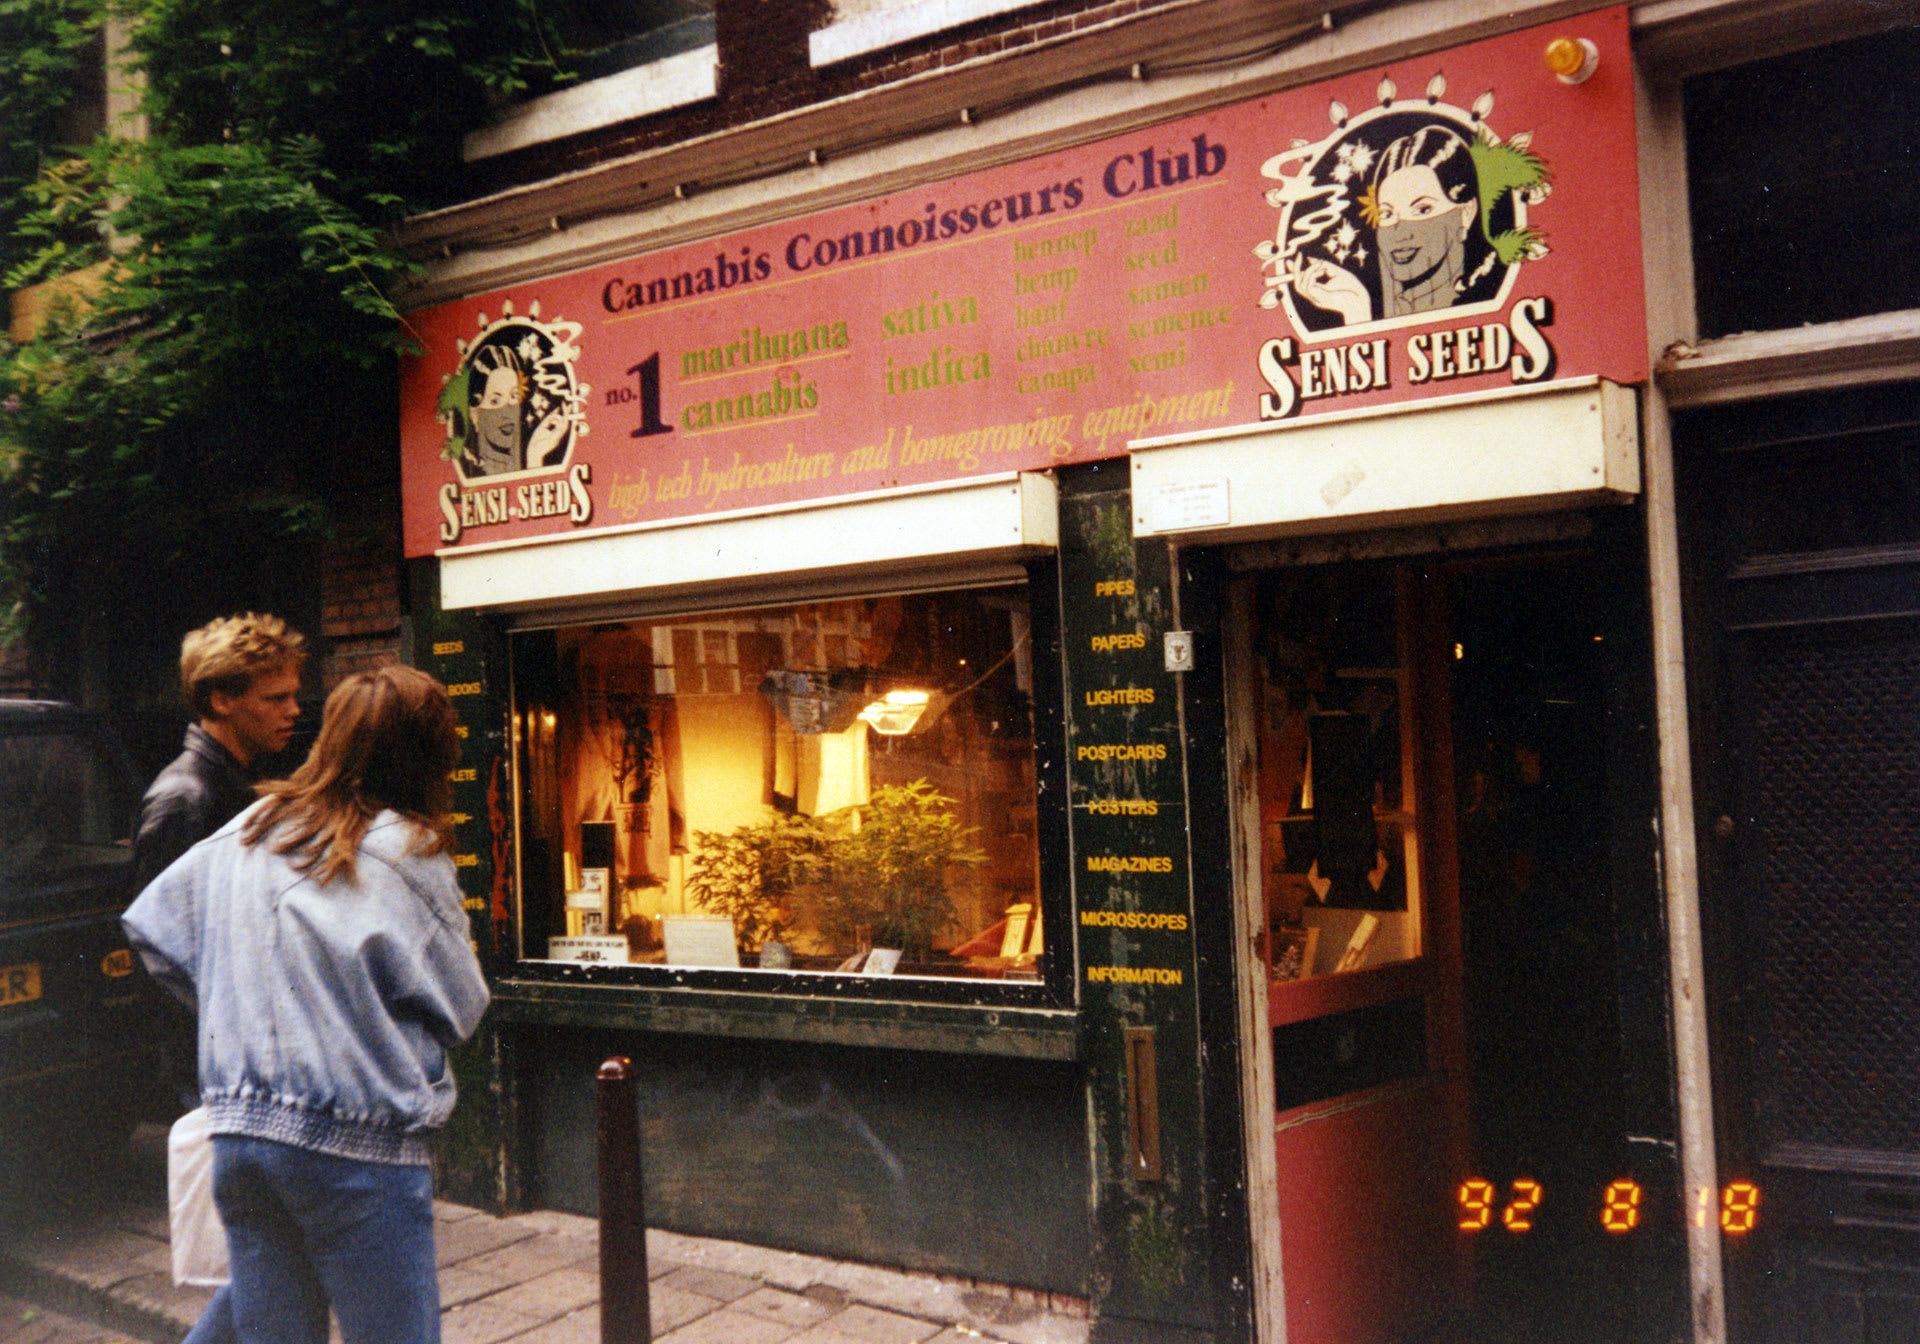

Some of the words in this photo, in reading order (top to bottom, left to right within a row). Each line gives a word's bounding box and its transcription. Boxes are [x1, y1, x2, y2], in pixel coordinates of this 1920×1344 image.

[601, 247, 770, 314] Cannabis
[784, 177, 1085, 272] Connoisseurs
[1103, 133, 1228, 198] Club
[1124, 203, 1179, 238] zaad
[1014, 226, 1097, 264] hennep
[1125, 239, 1179, 272] seed
[1014, 264, 1079, 297] hemp
[1127, 271, 1209, 306] samen
[881, 290, 979, 340] sativa
[1015, 297, 1067, 329] hanf
[1127, 303, 1232, 341] semence
[677, 320, 849, 379] marihuana
[1016, 325, 1110, 363] chanvre
[1128, 341, 1187, 375] semi
[1258, 337, 1390, 421] SENSI
[1407, 296, 1554, 385] SEEDS
[885, 346, 992, 396] indica
[1017, 363, 1097, 395] canapa
[604, 386, 638, 407] no.
[626, 350, 674, 438] 1
[681, 373, 819, 432] cannabis
[608, 472, 649, 519] high
[656, 462, 692, 502] tech
[699, 443, 835, 511] hydroculture
[841, 428, 894, 471] and
[900, 407, 1074, 472] homegrowing
[1082, 380, 1236, 452] equipment
[439, 482, 510, 544] SENSI
[516, 464, 592, 525] SEEDS
[1096, 580, 1136, 597] PIPES
[433, 641, 464, 655] SEEDS
[1091, 634, 1146, 651] PAPERS
[1086, 688, 1155, 706] LIGHTERS
[1077, 745, 1167, 761] POSTCARDS
[451, 769, 477, 782] LETE
[1088, 800, 1159, 816] POSTERS
[1087, 857, 1173, 872] MAGAZINES
[1081, 911, 1188, 930] MICROSCOPES
[1087, 966, 1182, 985] INFORMATION
